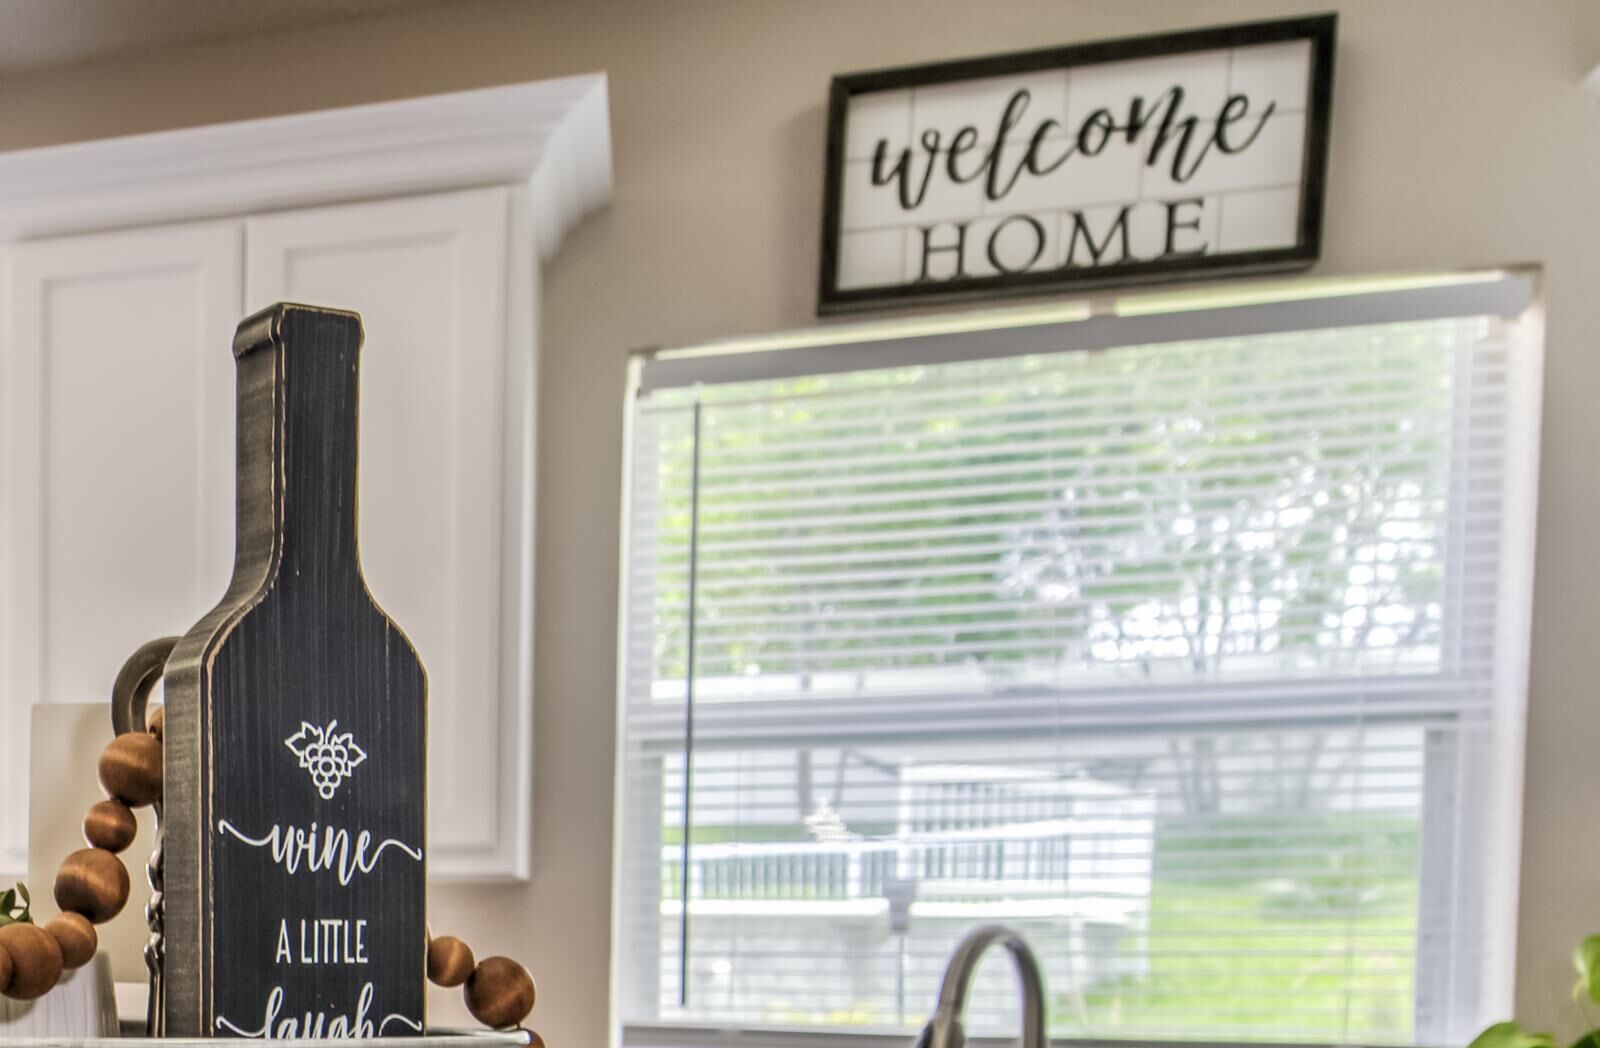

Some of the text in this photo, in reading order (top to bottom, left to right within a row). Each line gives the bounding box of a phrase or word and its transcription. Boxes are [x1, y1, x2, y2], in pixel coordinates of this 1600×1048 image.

[871, 85, 1276, 210] welcome
[914, 200, 1209, 283] HOME
[217, 818, 423, 886] wine
[276, 918, 369, 964] A LITTLE
